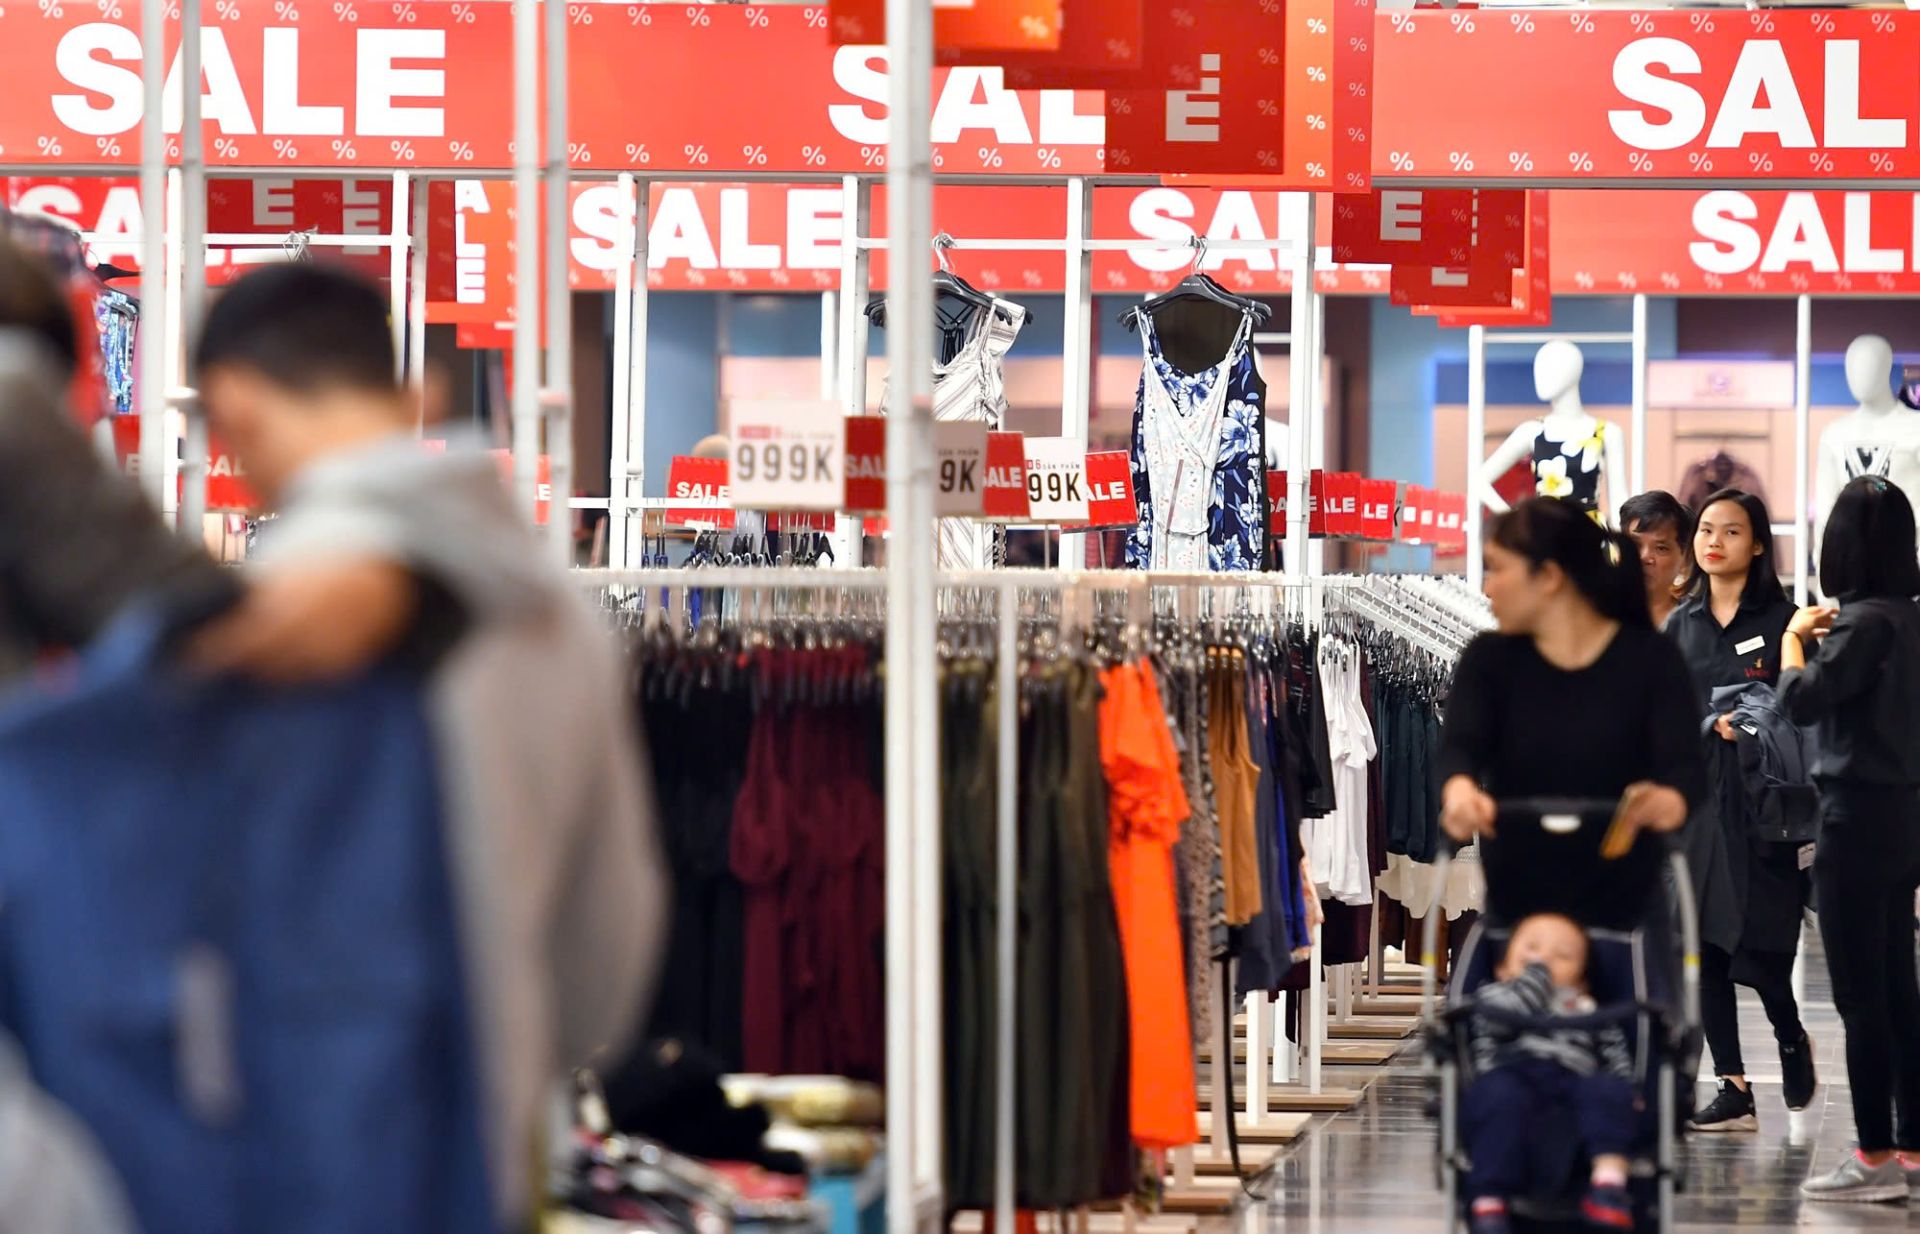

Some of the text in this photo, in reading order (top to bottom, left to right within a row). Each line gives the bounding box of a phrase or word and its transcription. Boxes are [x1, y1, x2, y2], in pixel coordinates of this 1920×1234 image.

[51, 22, 446, 137] SALE
[570, 187, 846, 270] SALE
[1127, 188, 1393, 271] SAL
[1688, 190, 1920, 274] SAL
[737, 444, 834, 482] 999K
[1028, 472, 1081, 502] 99K
